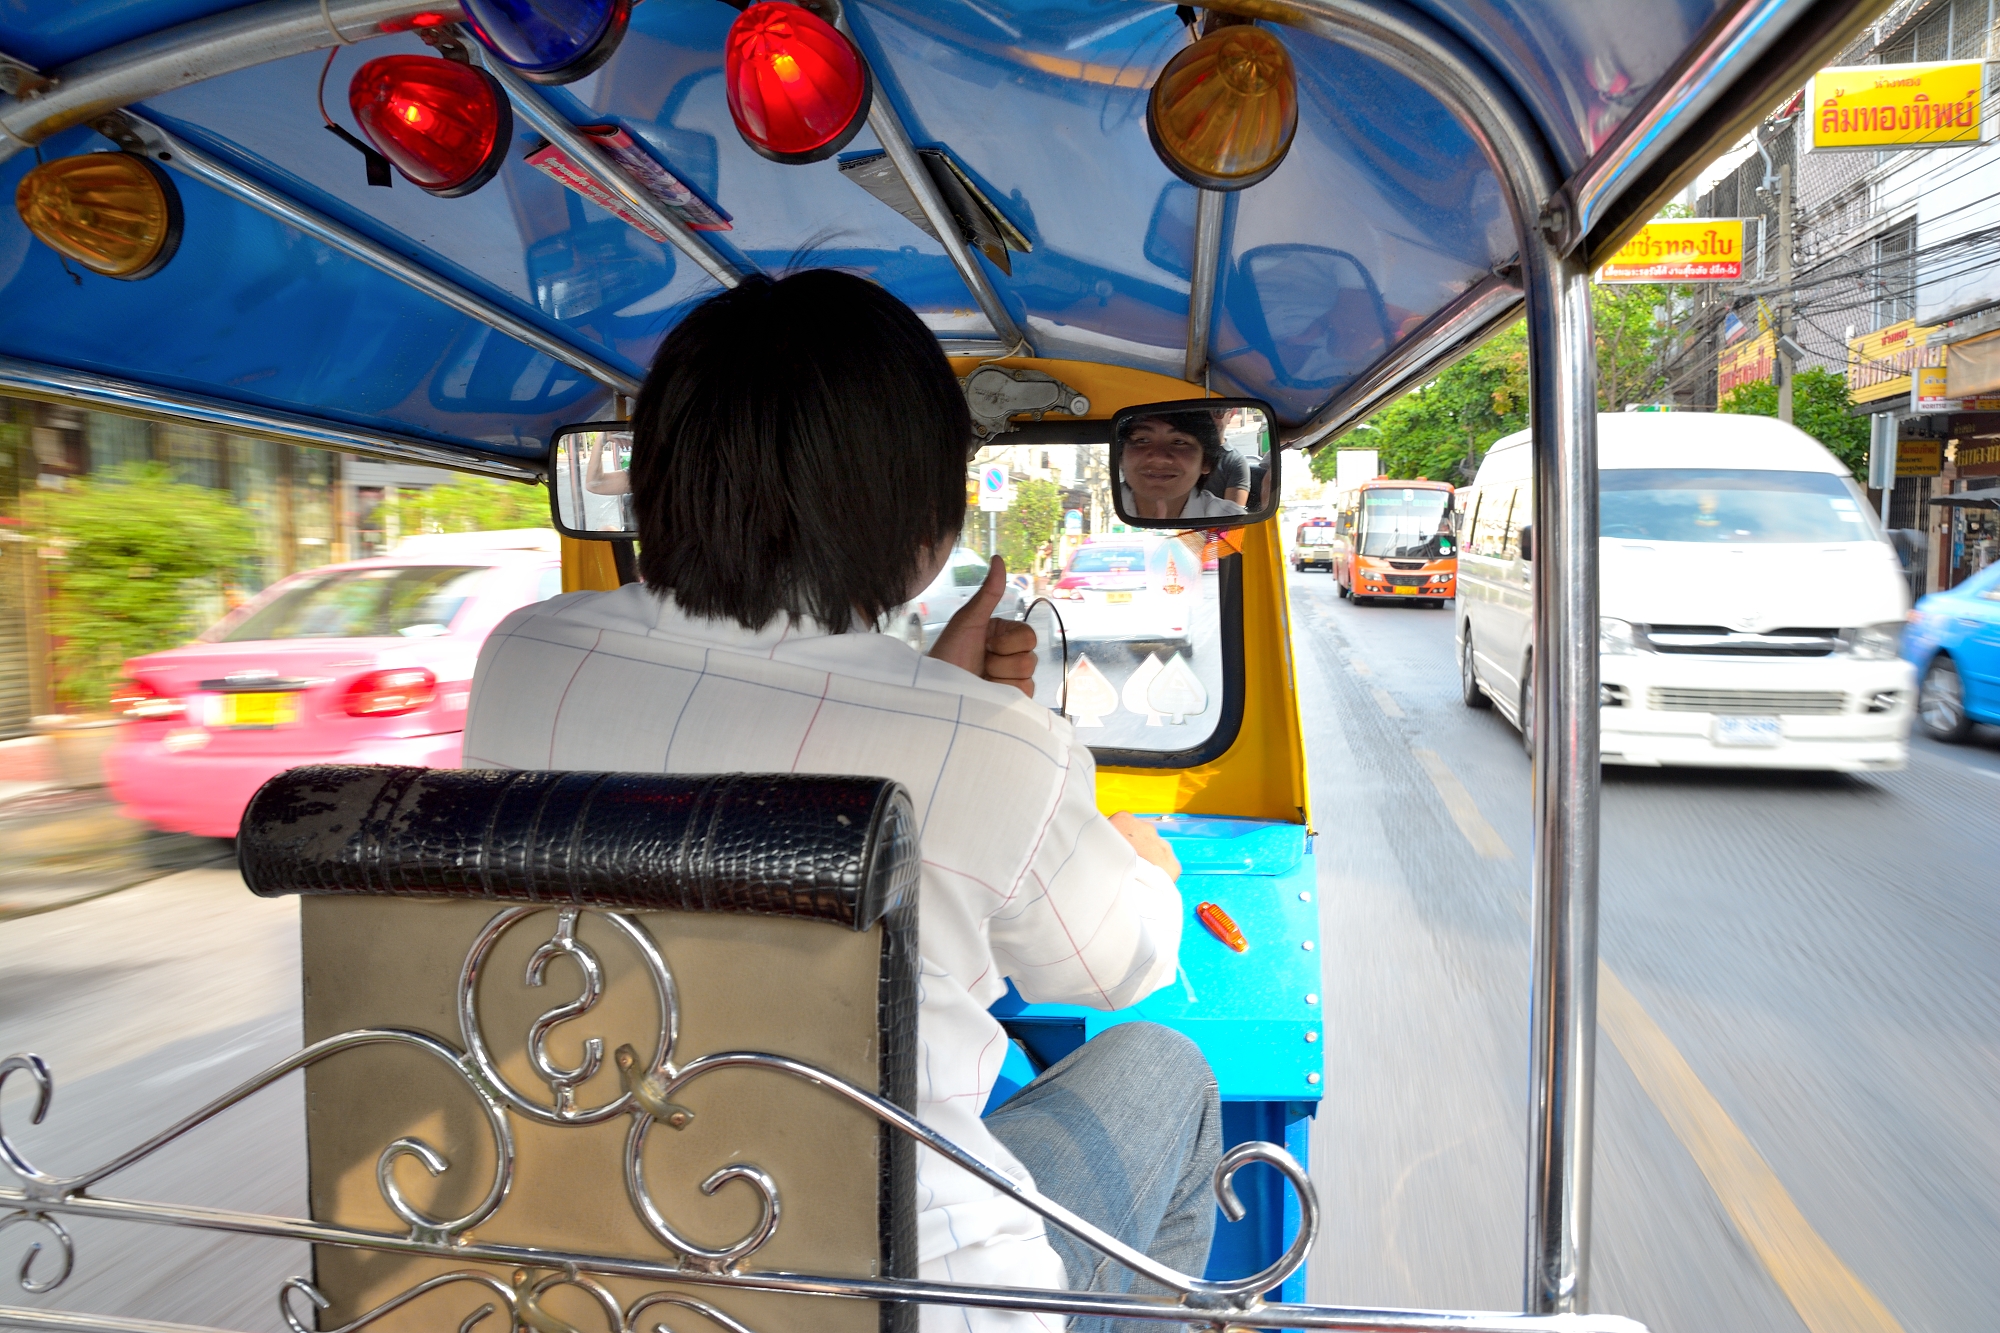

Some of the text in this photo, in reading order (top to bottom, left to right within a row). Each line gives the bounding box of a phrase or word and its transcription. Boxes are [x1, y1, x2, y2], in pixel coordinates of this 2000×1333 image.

[1874, 76, 1921, 89] ห้างทอง
[1821, 88, 1976, 133] ลิ้มทองทิพย์
[1612, 229, 1733, 258] พชรทองใบ
